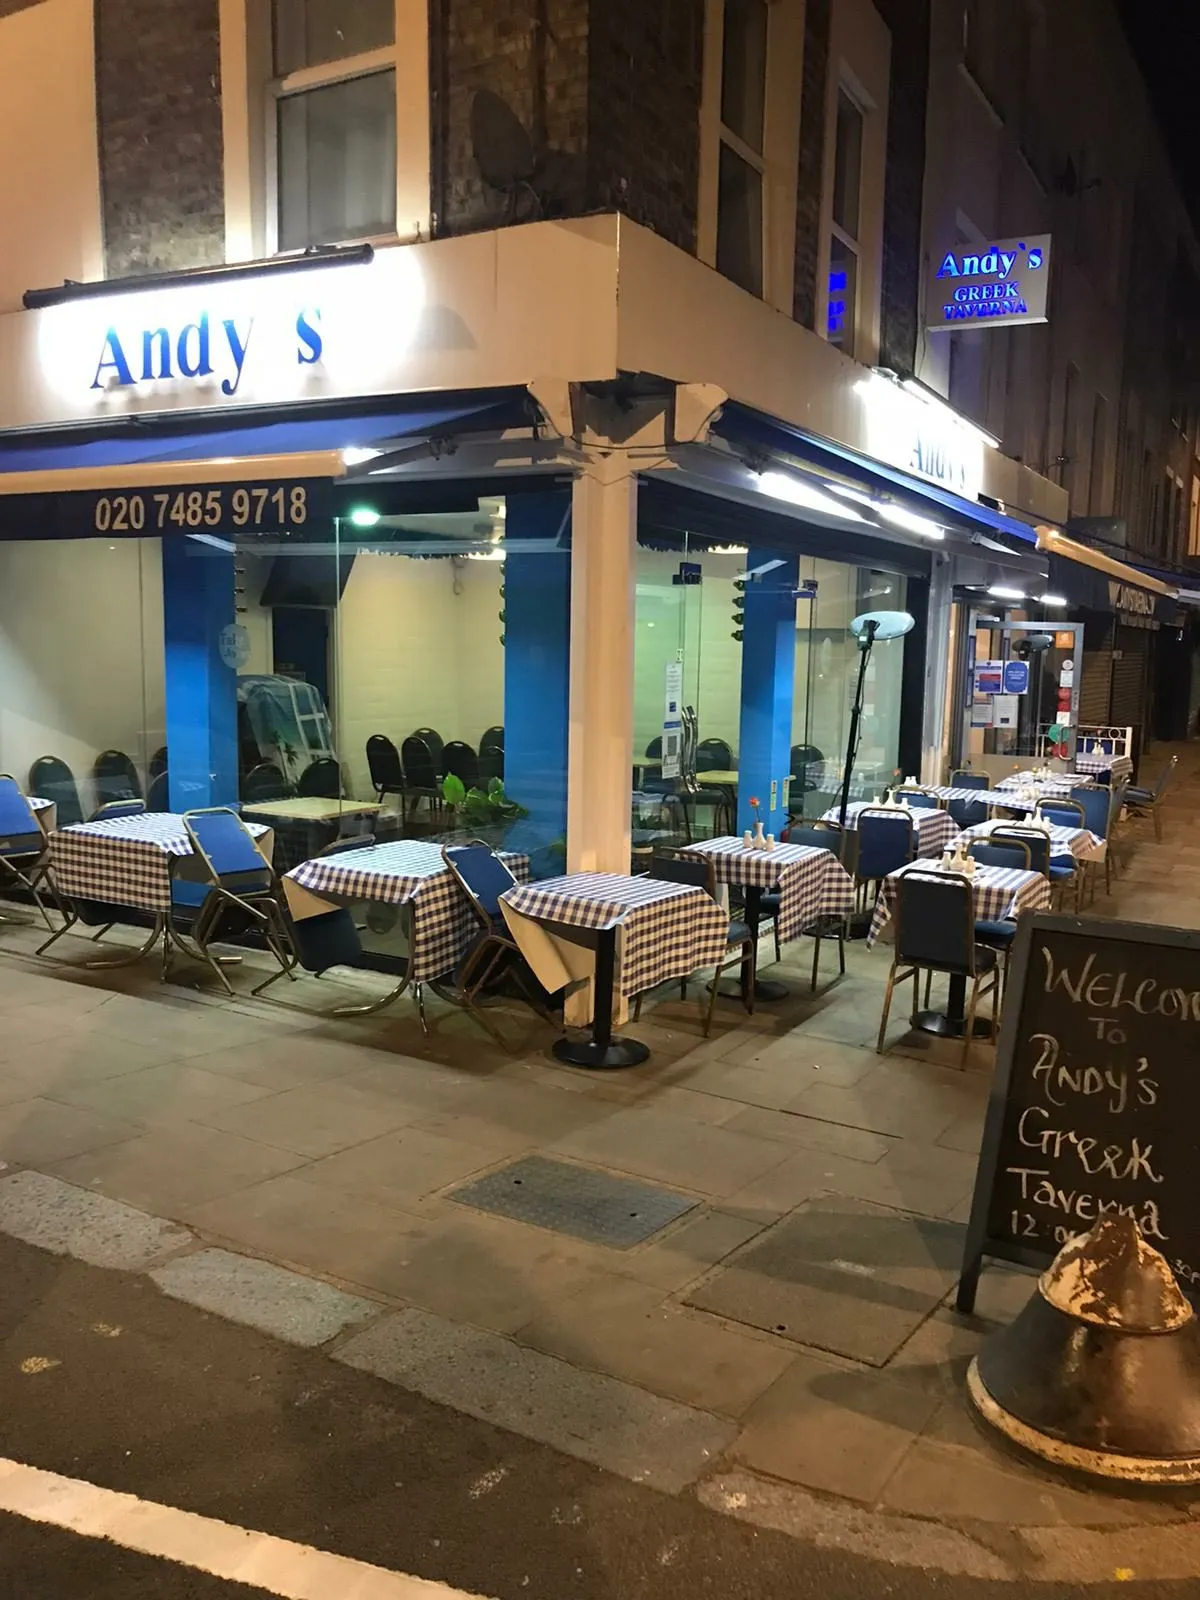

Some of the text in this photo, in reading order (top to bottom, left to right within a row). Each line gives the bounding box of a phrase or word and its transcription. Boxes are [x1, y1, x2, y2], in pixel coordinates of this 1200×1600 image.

[953, 281, 1019, 303] GREEK
[944, 298, 1028, 320] TAVERNA
[94, 486, 308, 531] 020 7485 9718
